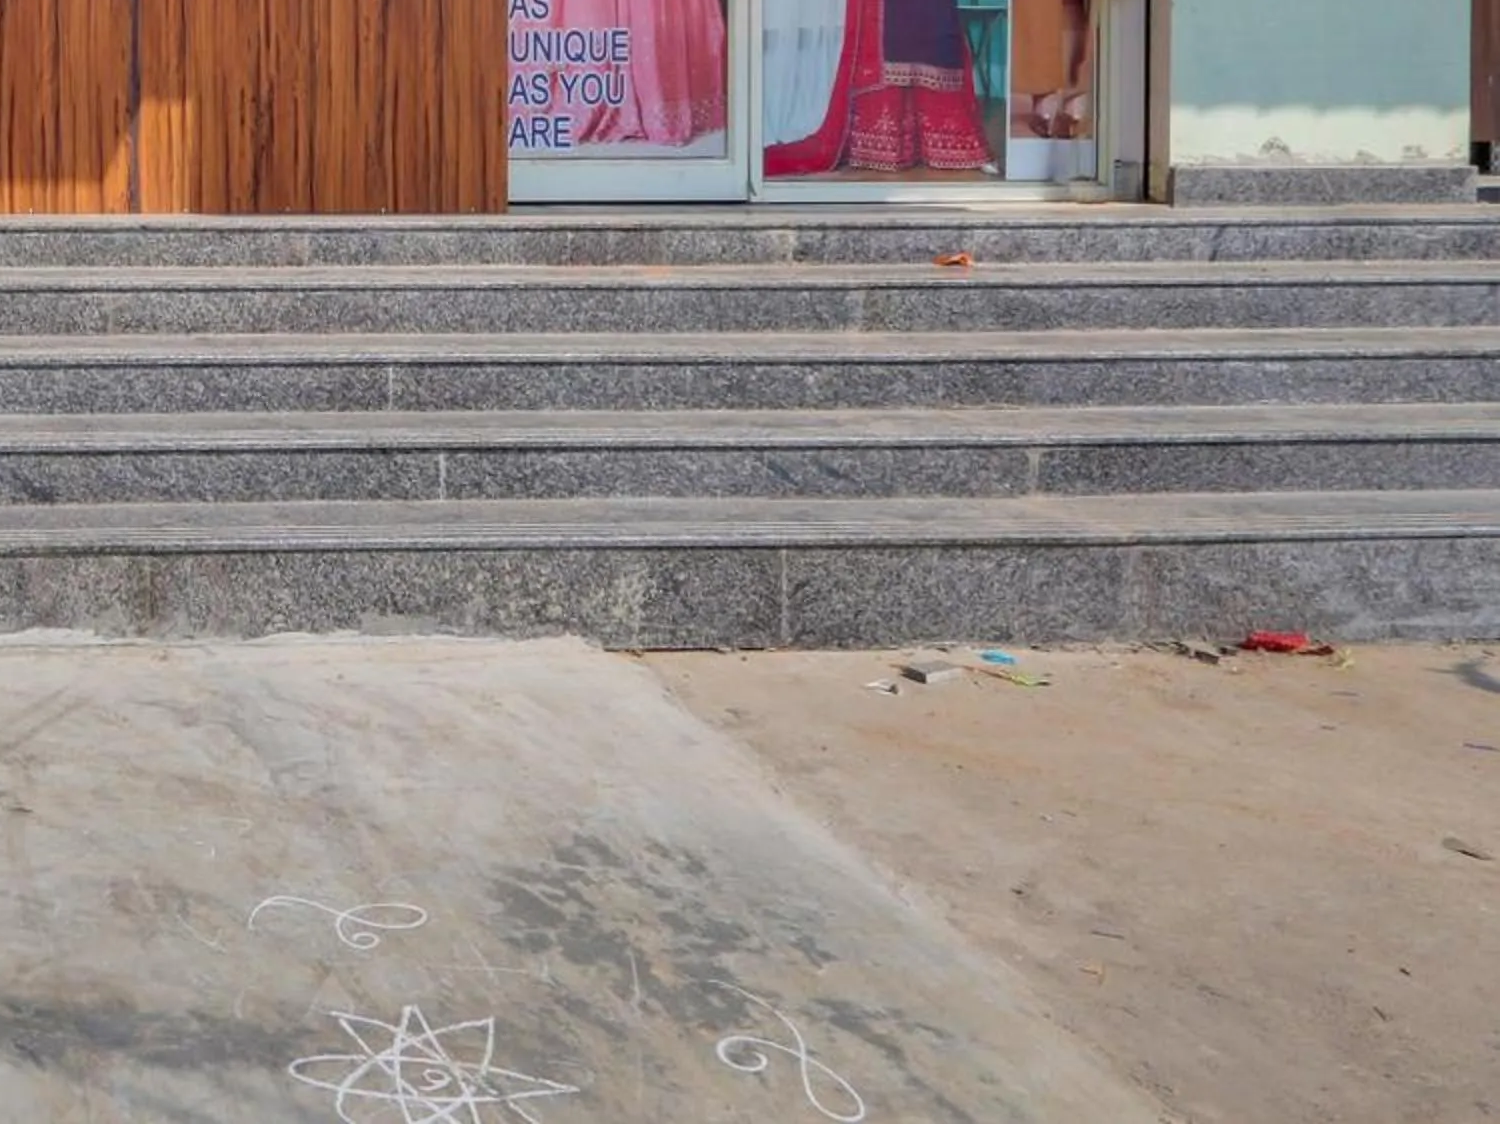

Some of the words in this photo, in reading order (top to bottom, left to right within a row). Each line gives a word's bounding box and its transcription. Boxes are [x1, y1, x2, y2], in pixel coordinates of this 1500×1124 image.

[510, 30, 629, 63] UNIQUE
[509, 73, 549, 105] AS
[560, 73, 625, 105] YOU
[509, 116, 572, 148] ARE
